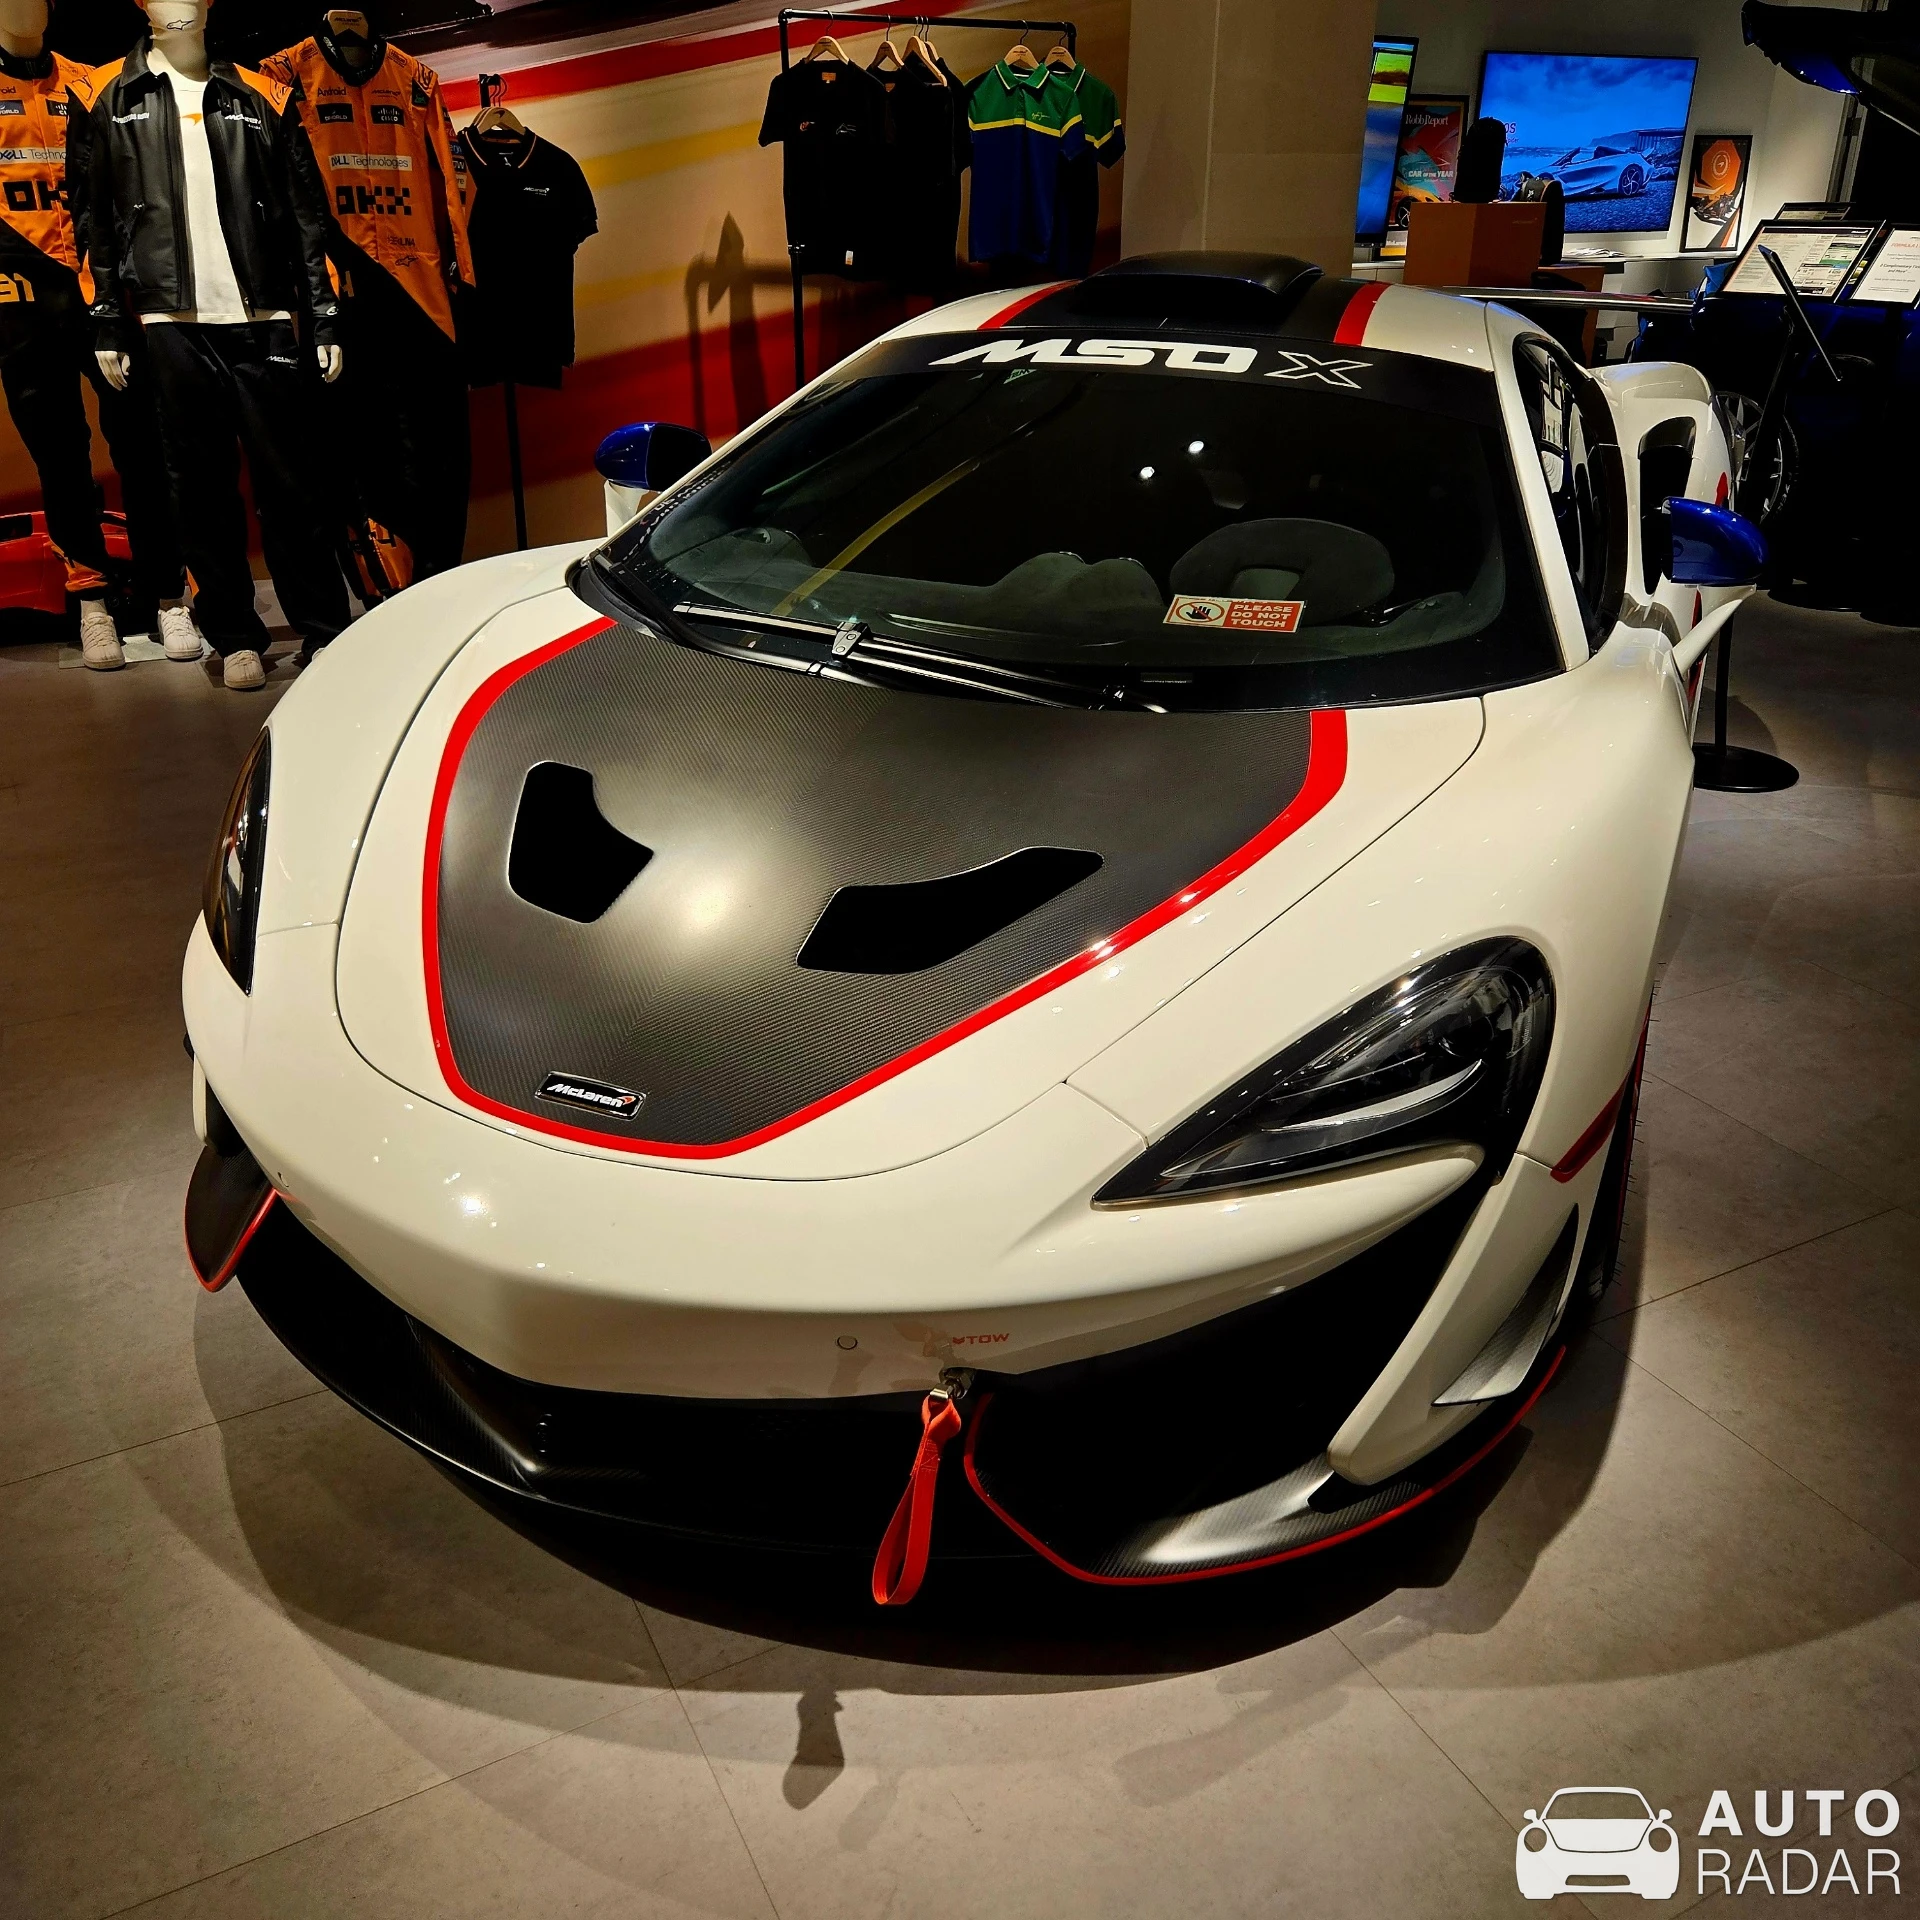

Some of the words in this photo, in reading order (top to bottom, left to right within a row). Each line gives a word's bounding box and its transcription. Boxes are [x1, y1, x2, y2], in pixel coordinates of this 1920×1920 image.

[317, 87, 347, 97] Android
[1405, 114, 1424, 124] Robb
[1425, 114, 1449, 127] Report
[352, 155, 409, 168] Technologies
[1408, 170, 1422, 178] CAR
[1437, 170, 1454, 178] YEAR
[336, 185, 412, 216] OKX
[1264, 350, 1374, 390] X
[1234, 604, 1293, 612] PLEASE
[1231, 618, 1286, 628] TOUCH
[546, 1083, 624, 1108] McLaren
[966, 1333, 1009, 1344] TOW
